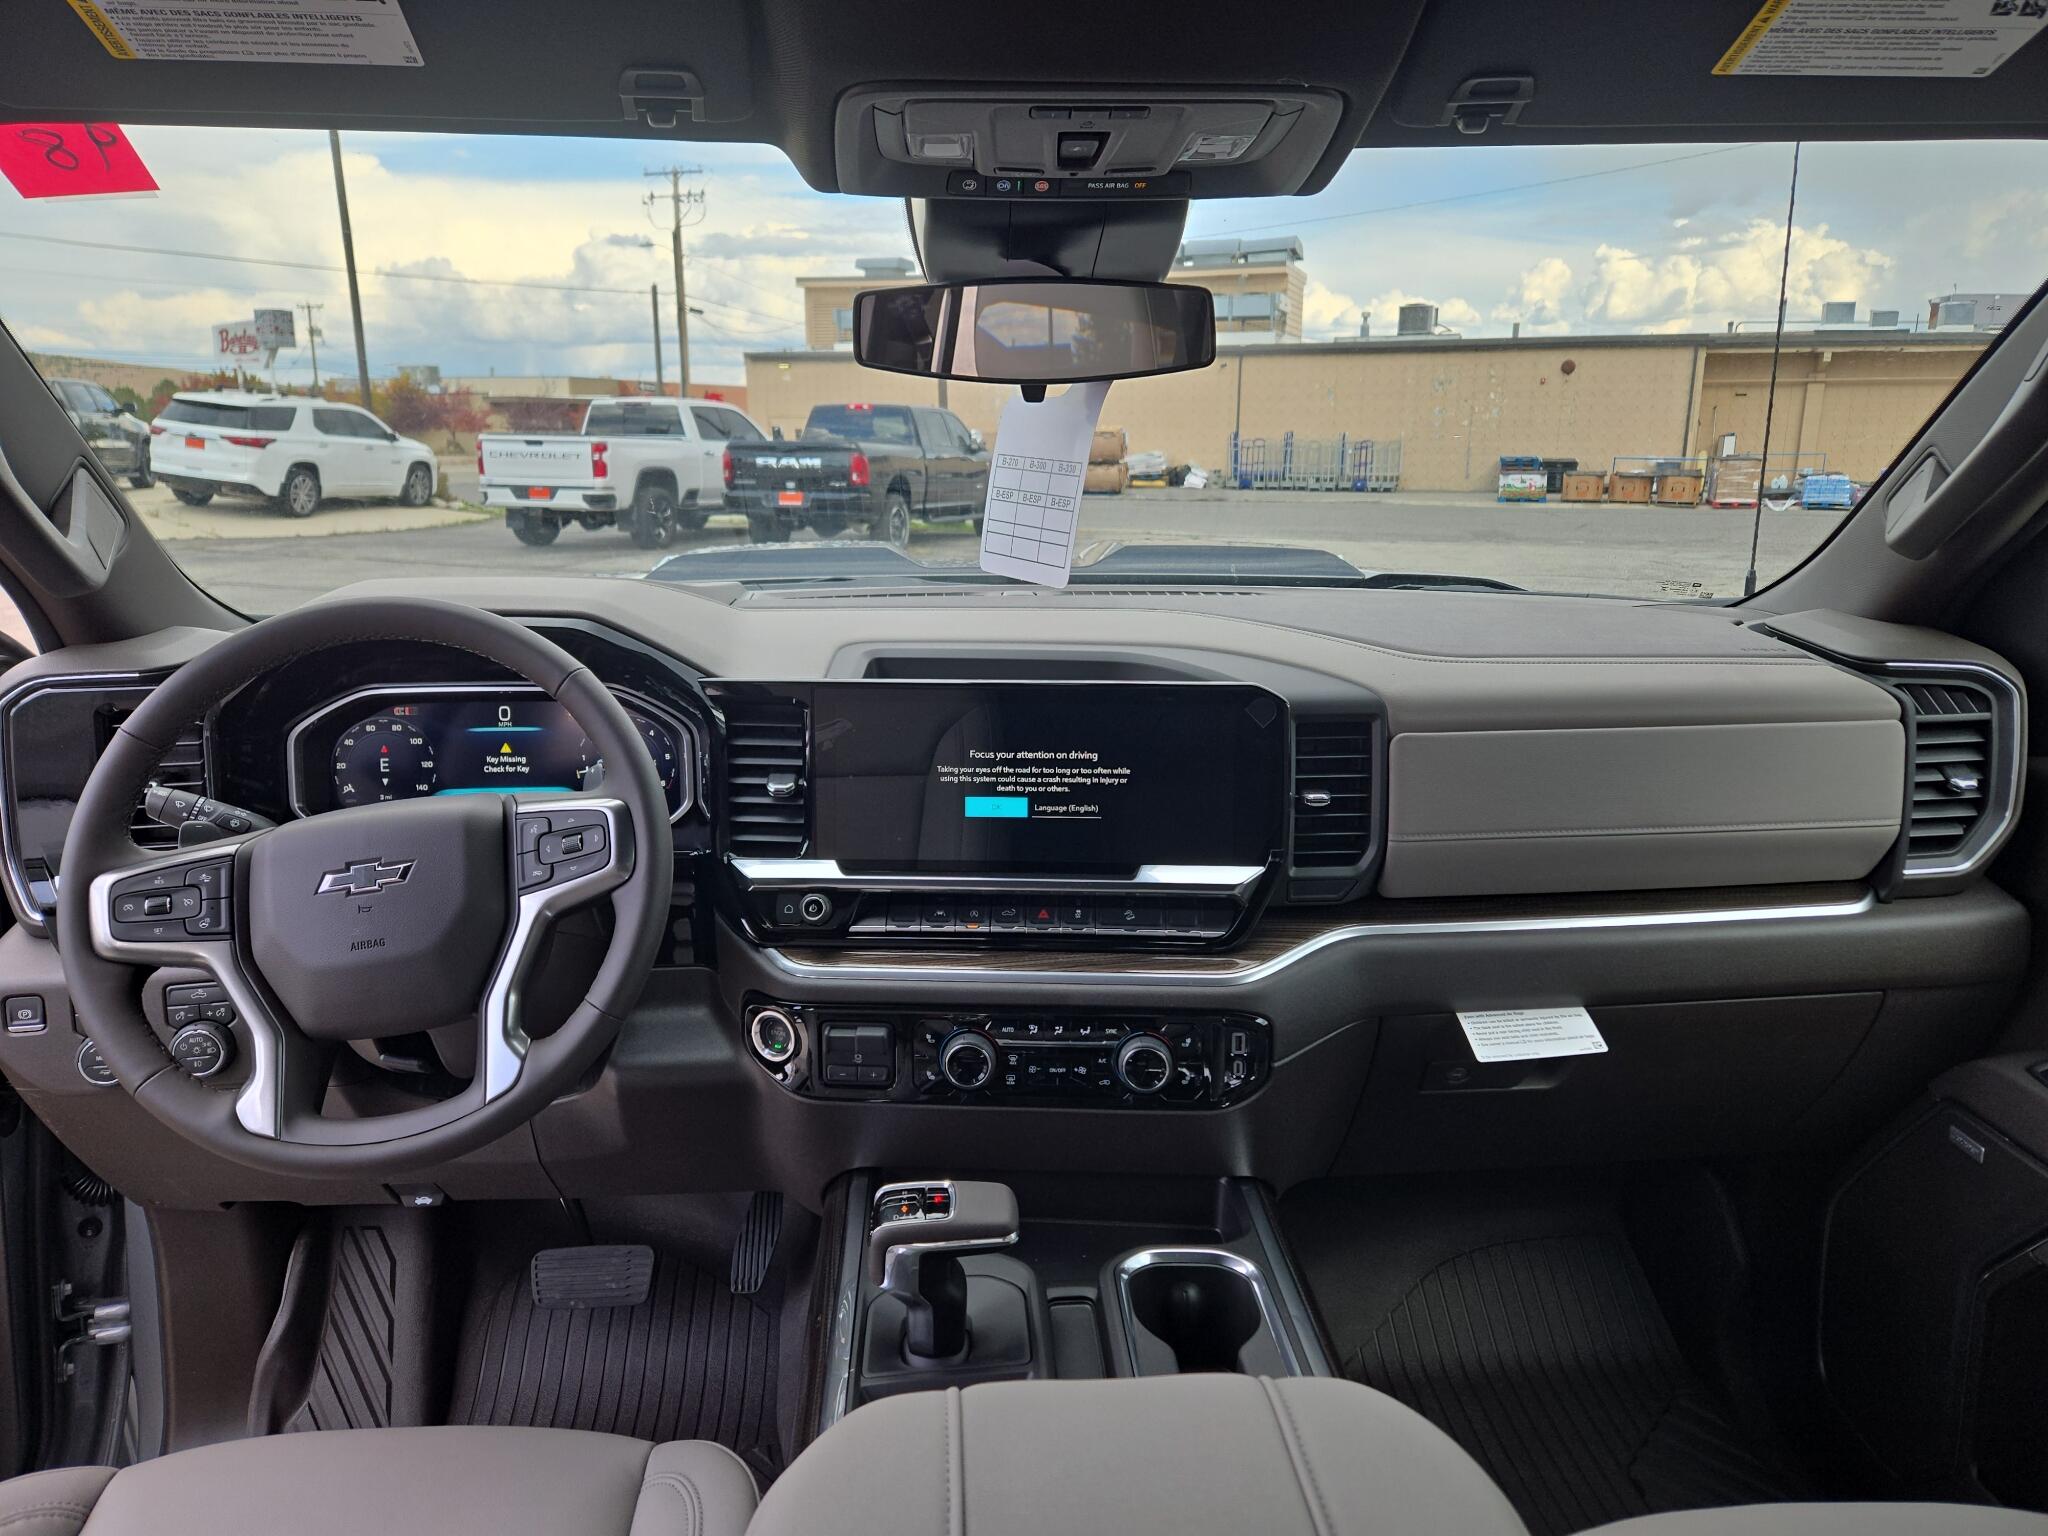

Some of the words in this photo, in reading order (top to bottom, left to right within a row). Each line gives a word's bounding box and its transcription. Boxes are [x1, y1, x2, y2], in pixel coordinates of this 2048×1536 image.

[104, 6, 137, 15] MÊME
[140, 8, 167, 16] AVEC
[292, 13, 363, 22] INTELLIGENTS
[488, 451, 581, 460] CHEVROLET
[756, 456, 822, 469] RAM
[995, 489, 1014, 499] B-ESP
[1022, 494, 1042, 504] B-ESP
[1050, 497, 1071, 509] B-ESP
[391, 724, 402, 732] 80
[343, 738, 354, 746] 40
[969, 749, 995, 759] Focus
[996, 751, 1015, 761] your
[1016, 750, 1055, 759] attention
[1069, 750, 1098, 762] driving
[380, 758, 390, 772] E
[486, 756, 499, 765] Key
[499, 756, 527, 764] Missing
[483, 765, 505, 773] Check
[516, 765, 530, 774] Key
[937, 765, 959, 774] Taking
[959, 767, 975, 775] your
[1031, 766, 1042, 774] for
[1055, 766, 1071, 775] long
[1093, 766, 1112, 774] often
[1112, 767, 1131, 775] while
[1061, 776, 1091, 785] resulting
[1099, 776, 1119, 785] injury
[1034, 804, 1067, 813] Language
[1068, 804, 1099, 813] (English)
[350, 937, 386, 952] AIRBAG
